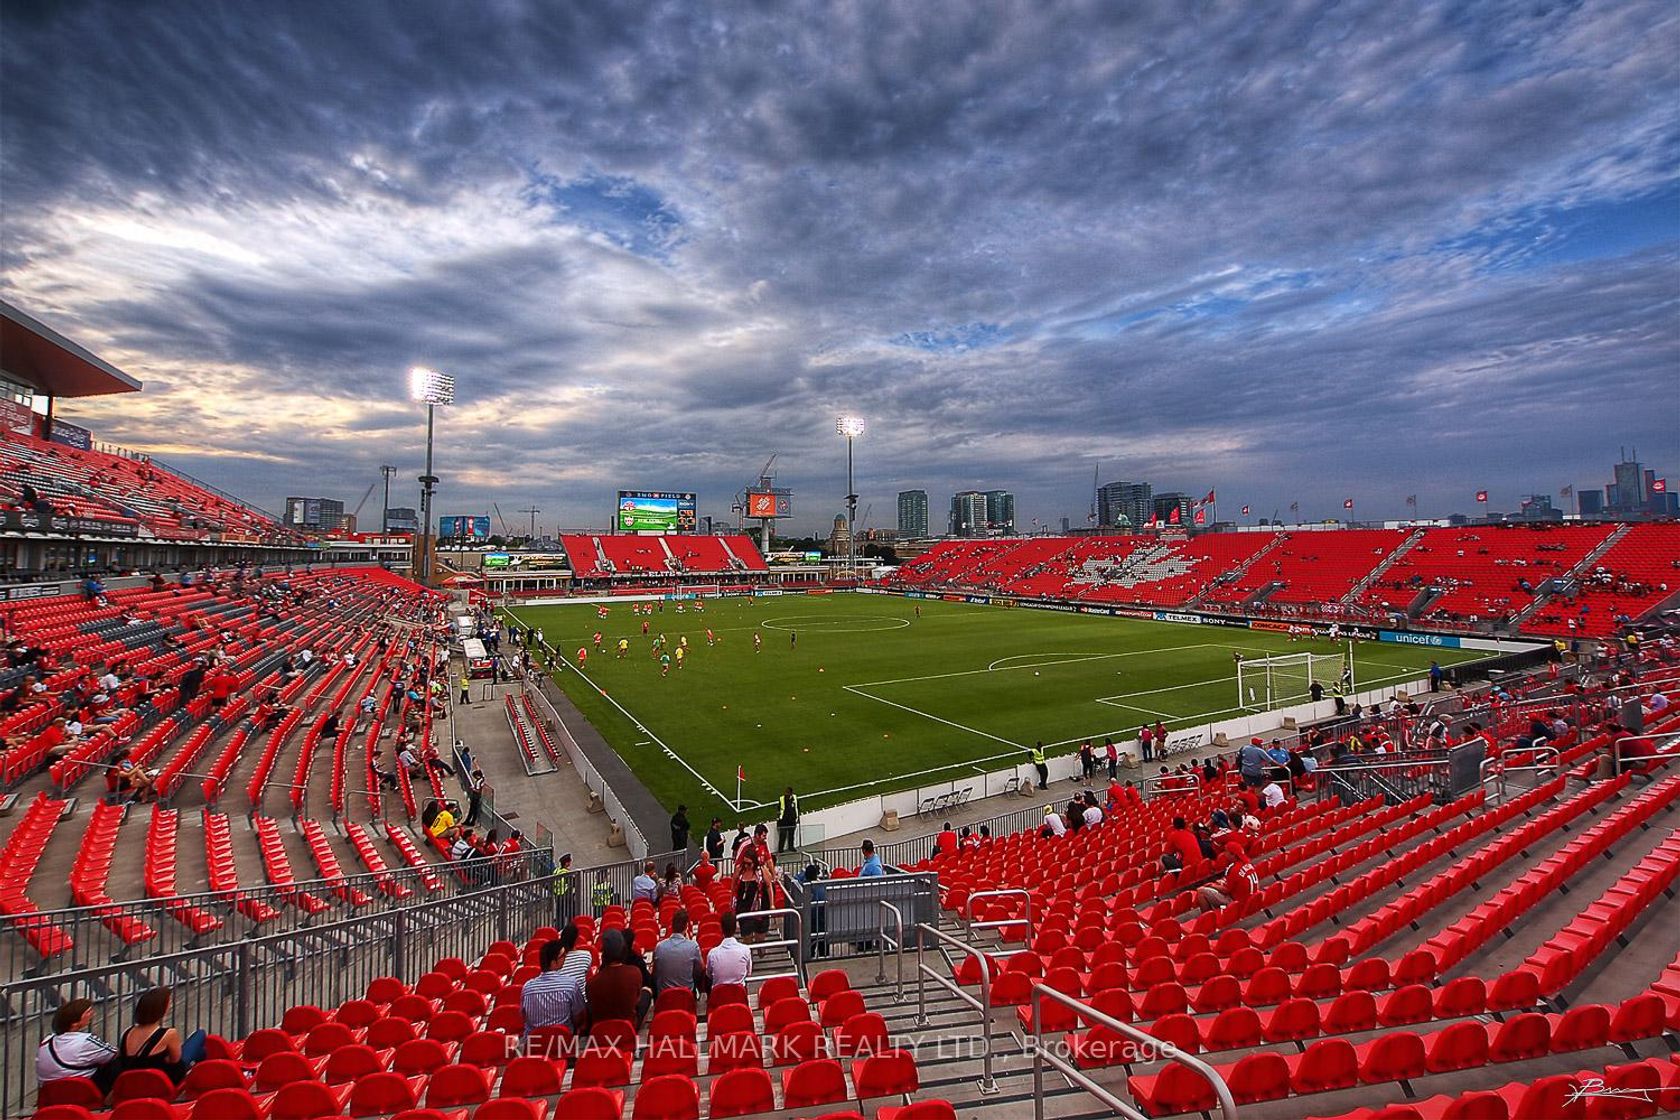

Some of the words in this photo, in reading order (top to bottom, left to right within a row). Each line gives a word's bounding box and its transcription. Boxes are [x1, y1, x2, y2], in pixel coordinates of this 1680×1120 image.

[1168, 614, 1198, 623] TELMEX
[1202, 616, 1226, 625] SONY
[1395, 633, 1431, 645] unicef
